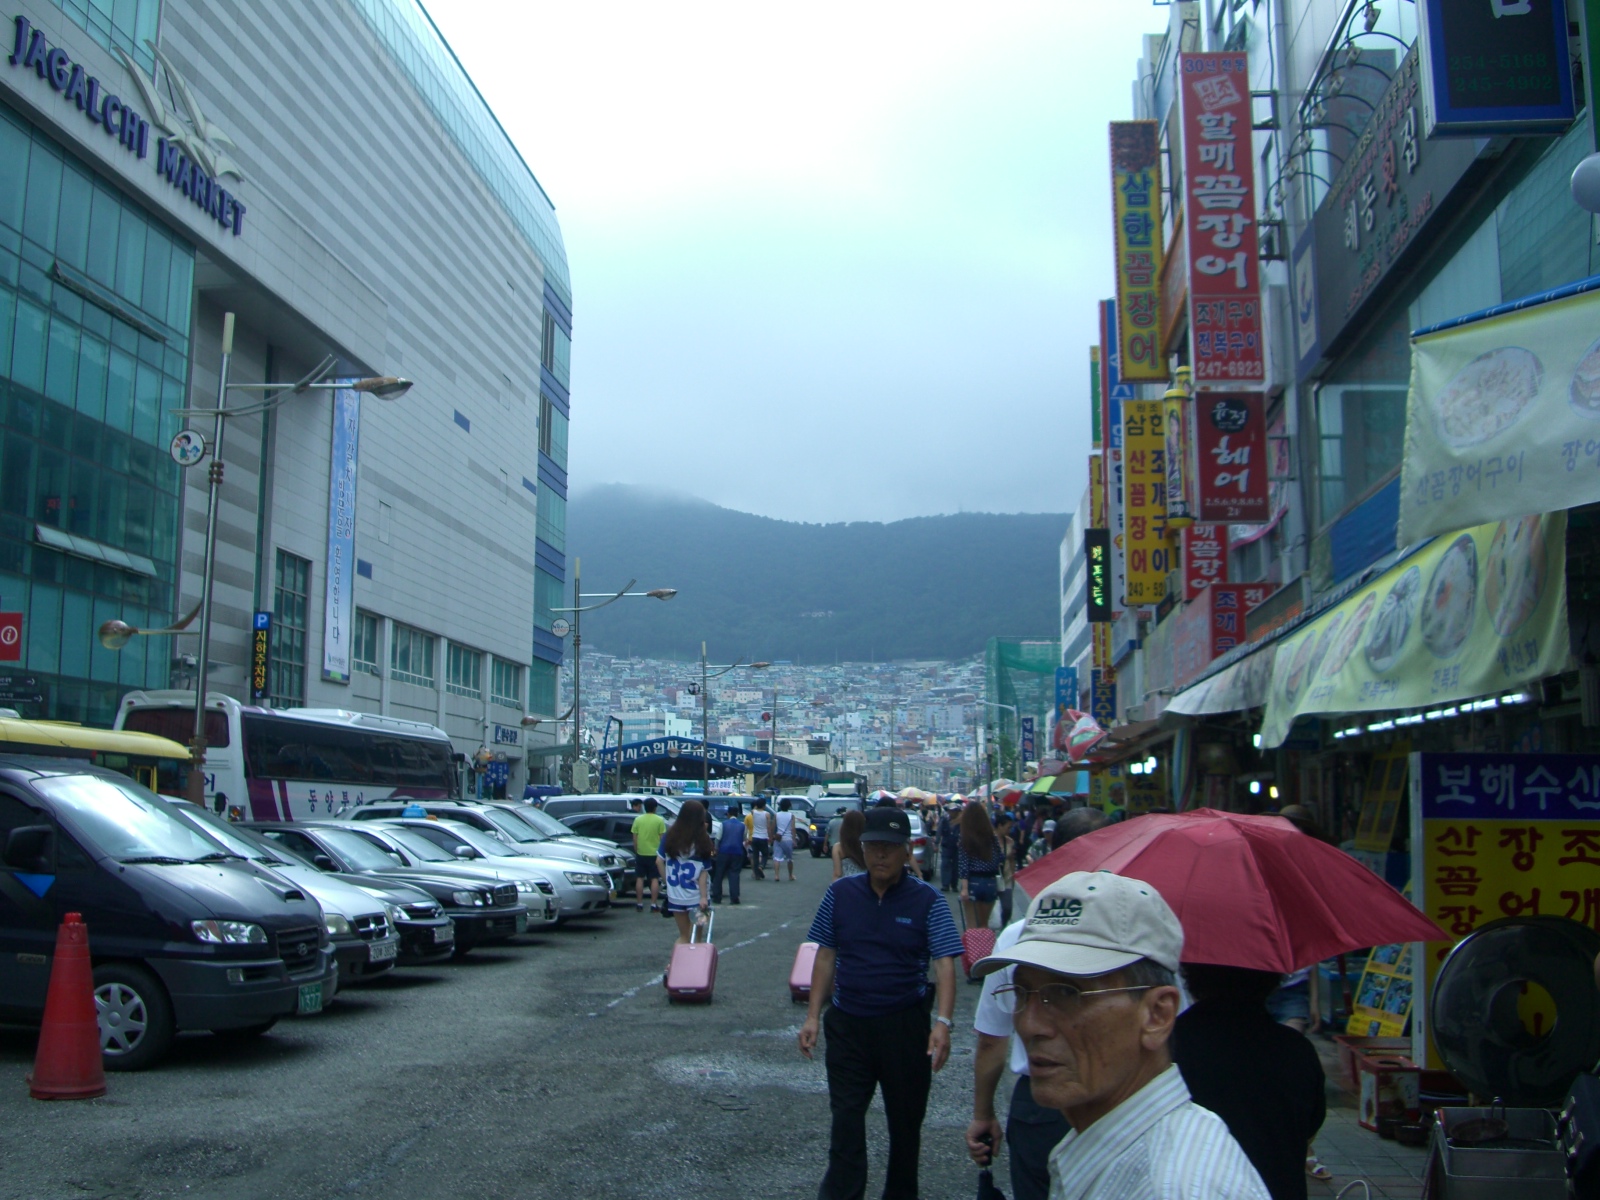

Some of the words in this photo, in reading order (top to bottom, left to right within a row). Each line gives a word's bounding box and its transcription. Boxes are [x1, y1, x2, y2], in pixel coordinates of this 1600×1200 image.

[1184, 58, 1217, 73] 30년
[1220, 58, 1248, 73] 전통
[8, 15, 150, 159] JAGALCHI
[157, 137, 247, 236] MARKET
[1196, 300, 1259, 328] 조개구이
[1198, 331, 1261, 358] 전복구이
[1211, 435, 1250, 494] 헤어
[257, 613, 268, 628] P
[254, 630, 267, 689] 지하주차장
[1435, 762, 1600, 811] 보해수산
[667, 858, 697, 890] 32
